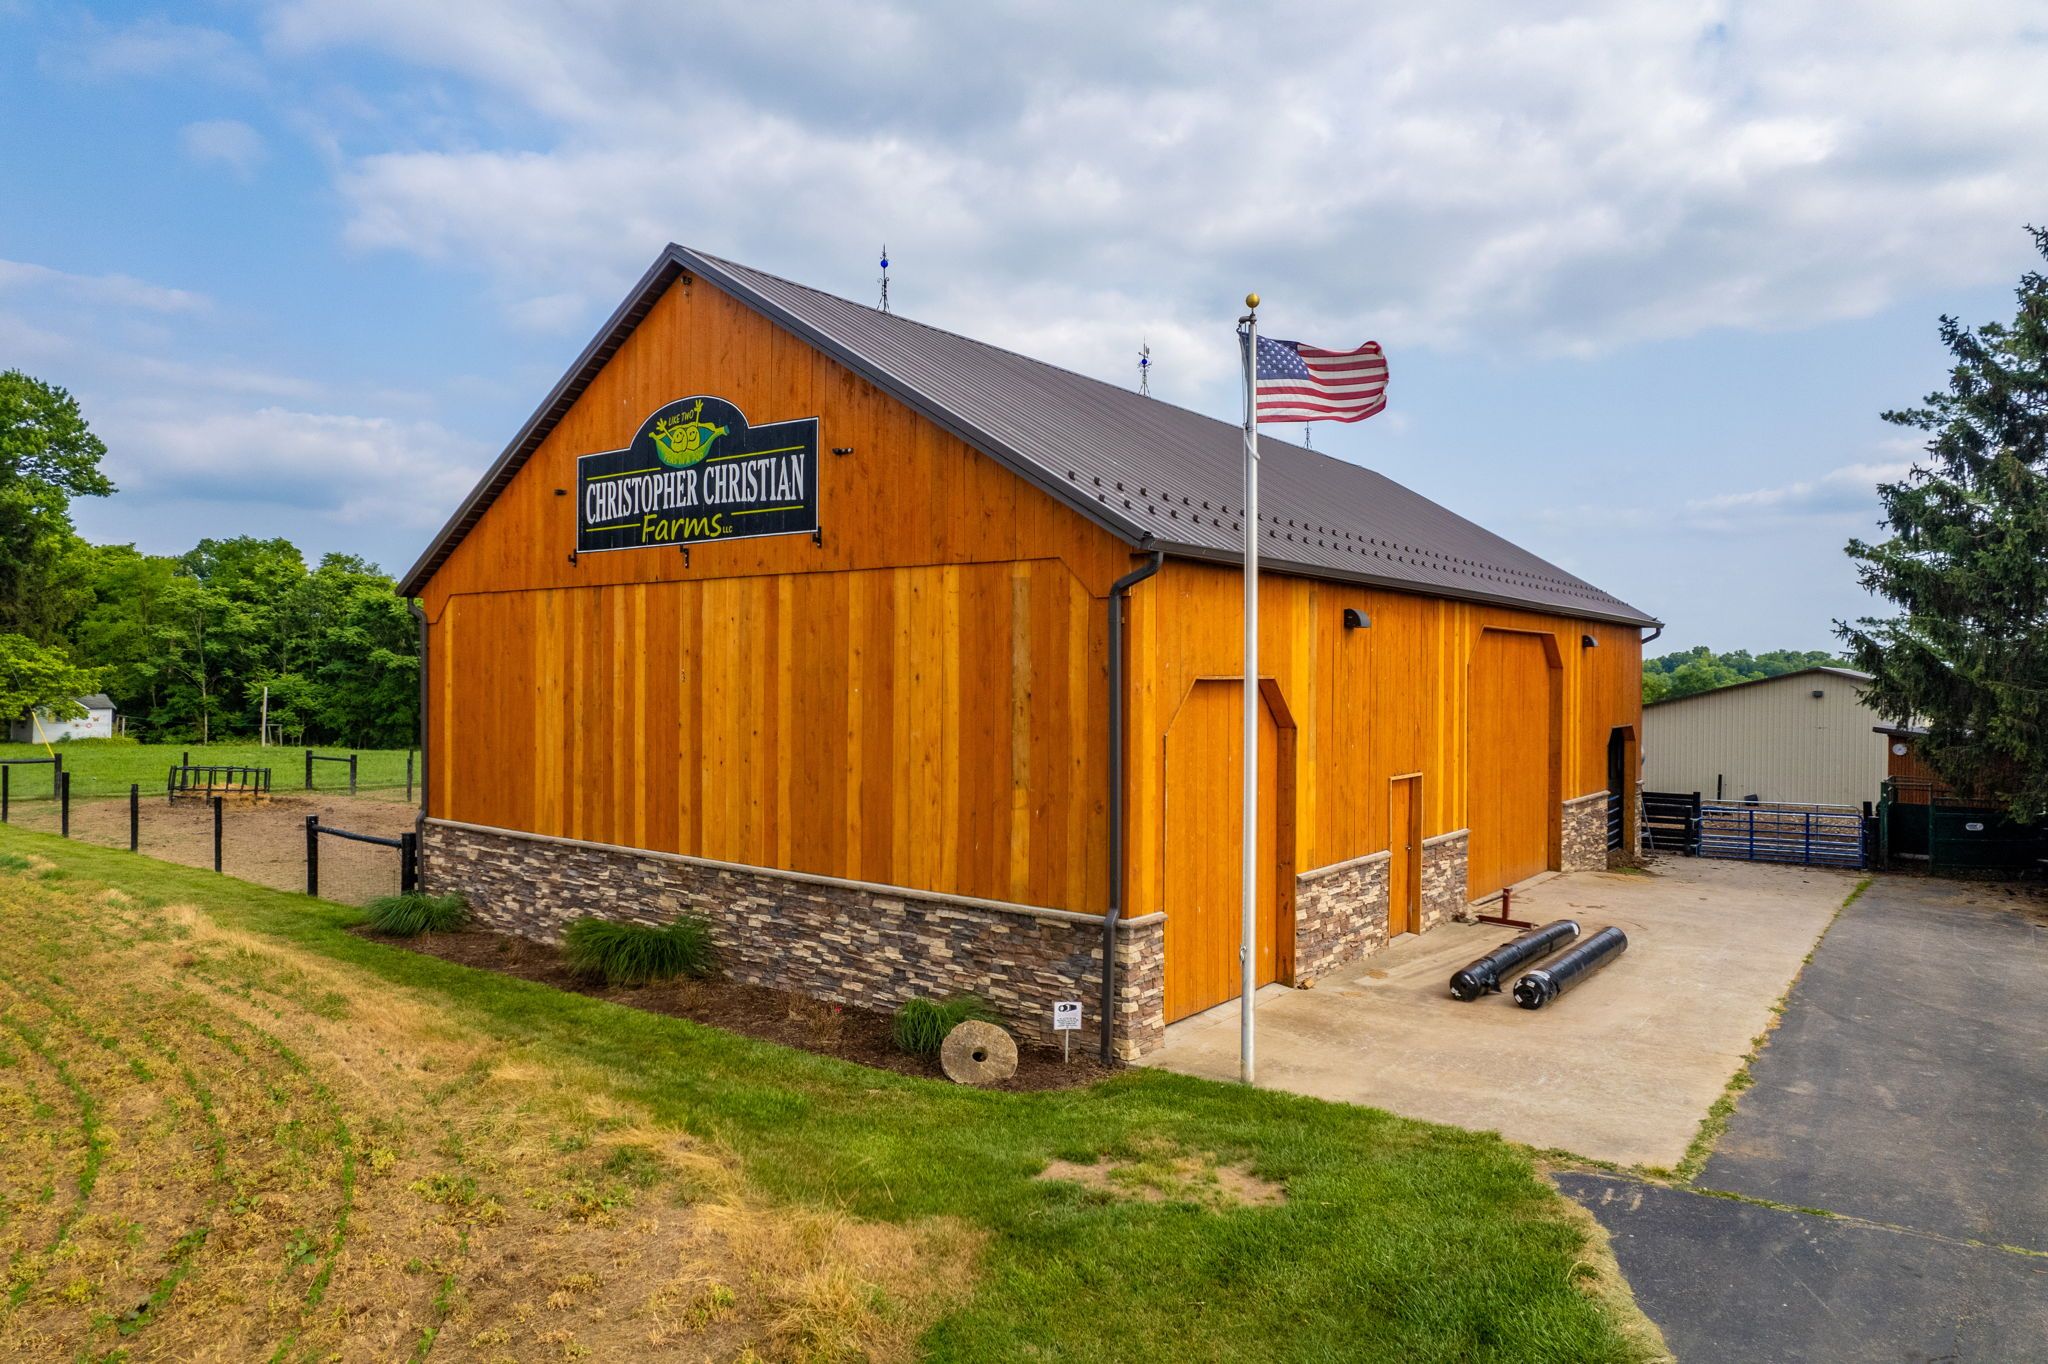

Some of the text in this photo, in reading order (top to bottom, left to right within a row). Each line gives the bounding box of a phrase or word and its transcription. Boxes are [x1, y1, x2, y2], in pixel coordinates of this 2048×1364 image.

[668, 409, 694, 426] LIKE TWO
[586, 454, 805, 524] CHRISTOPHER CHRISTIAN
[642, 513, 733, 543] Farms LLC
